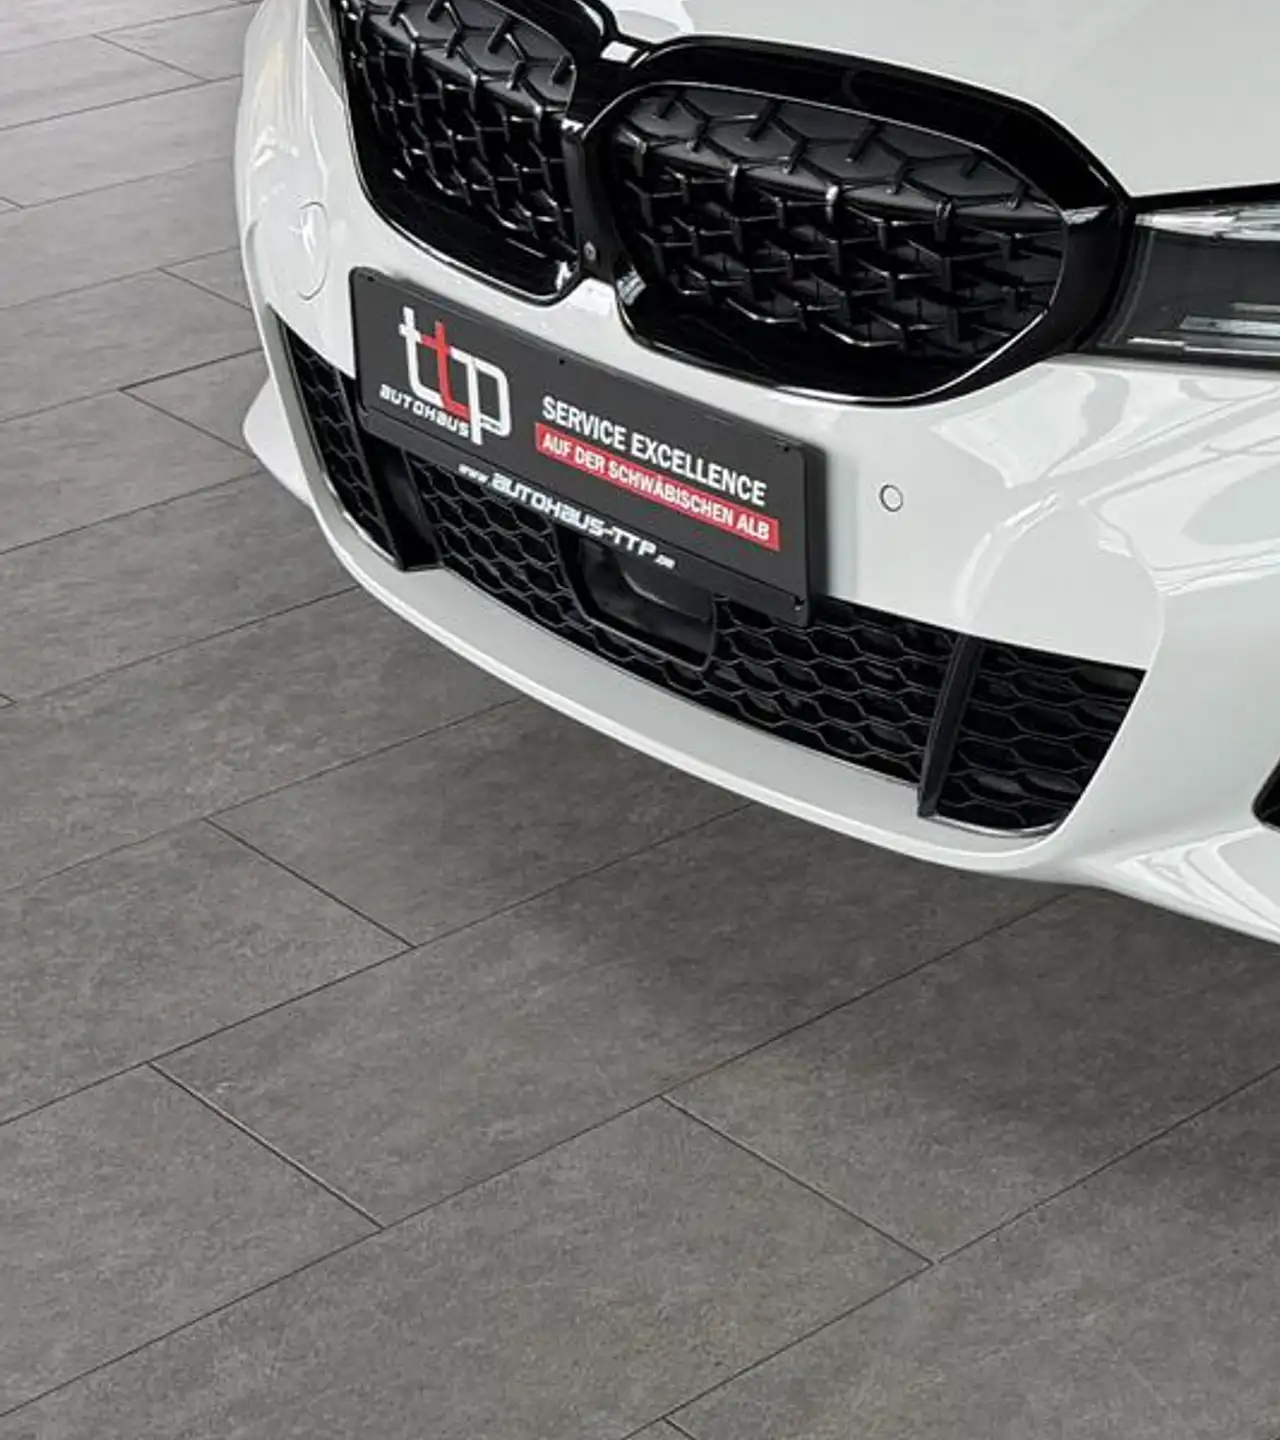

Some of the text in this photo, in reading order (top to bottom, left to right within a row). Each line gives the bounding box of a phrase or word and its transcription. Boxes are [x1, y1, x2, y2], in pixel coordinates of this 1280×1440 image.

[541, 395, 768, 508] SERVICE EXCELLENCE
[541, 432, 574, 458] AUF
[574, 447, 605, 474] DER
[736, 513, 771, 542] ALB
